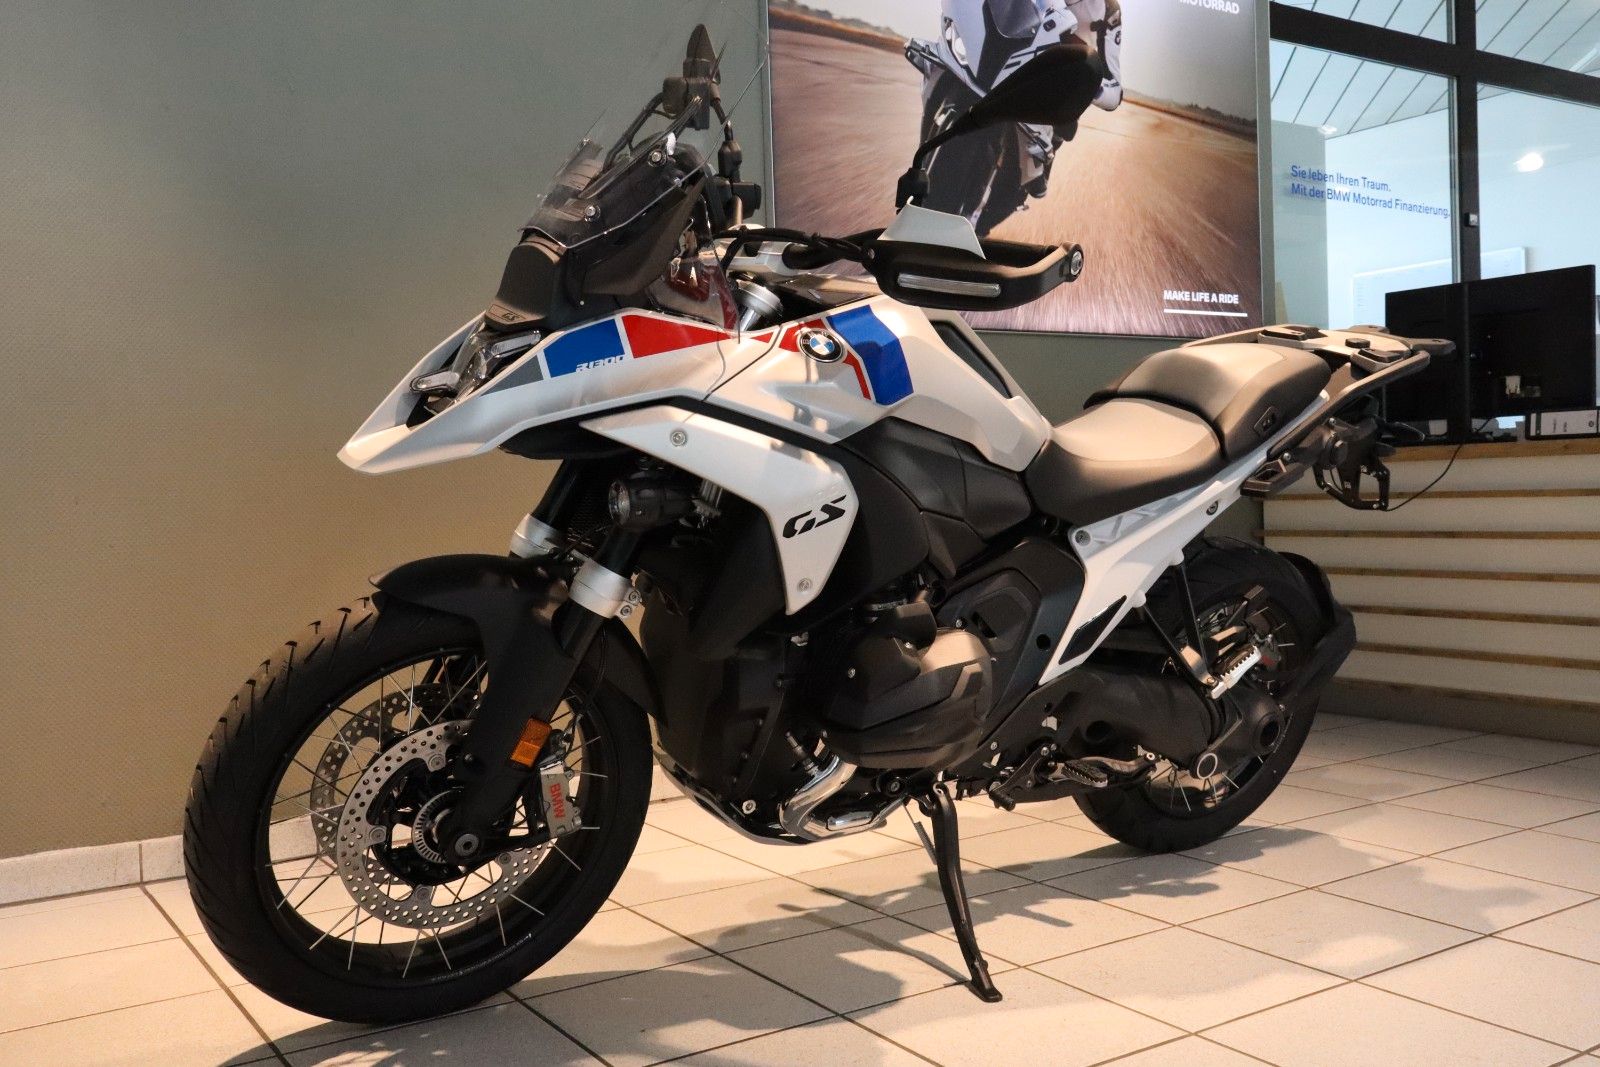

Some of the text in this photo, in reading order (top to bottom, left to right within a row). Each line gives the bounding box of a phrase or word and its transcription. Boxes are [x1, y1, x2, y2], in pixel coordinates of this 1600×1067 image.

[1291, 165, 1392, 192] Sie leben Ihren Traum.
[1291, 183, 1451, 219] Mit der BMW Motorrad Finanzierung.
[1163, 290, 1239, 304] MAKE LIFE A RIDE
[782, 494, 847, 538] GS
[551, 783, 565, 817] BMW
